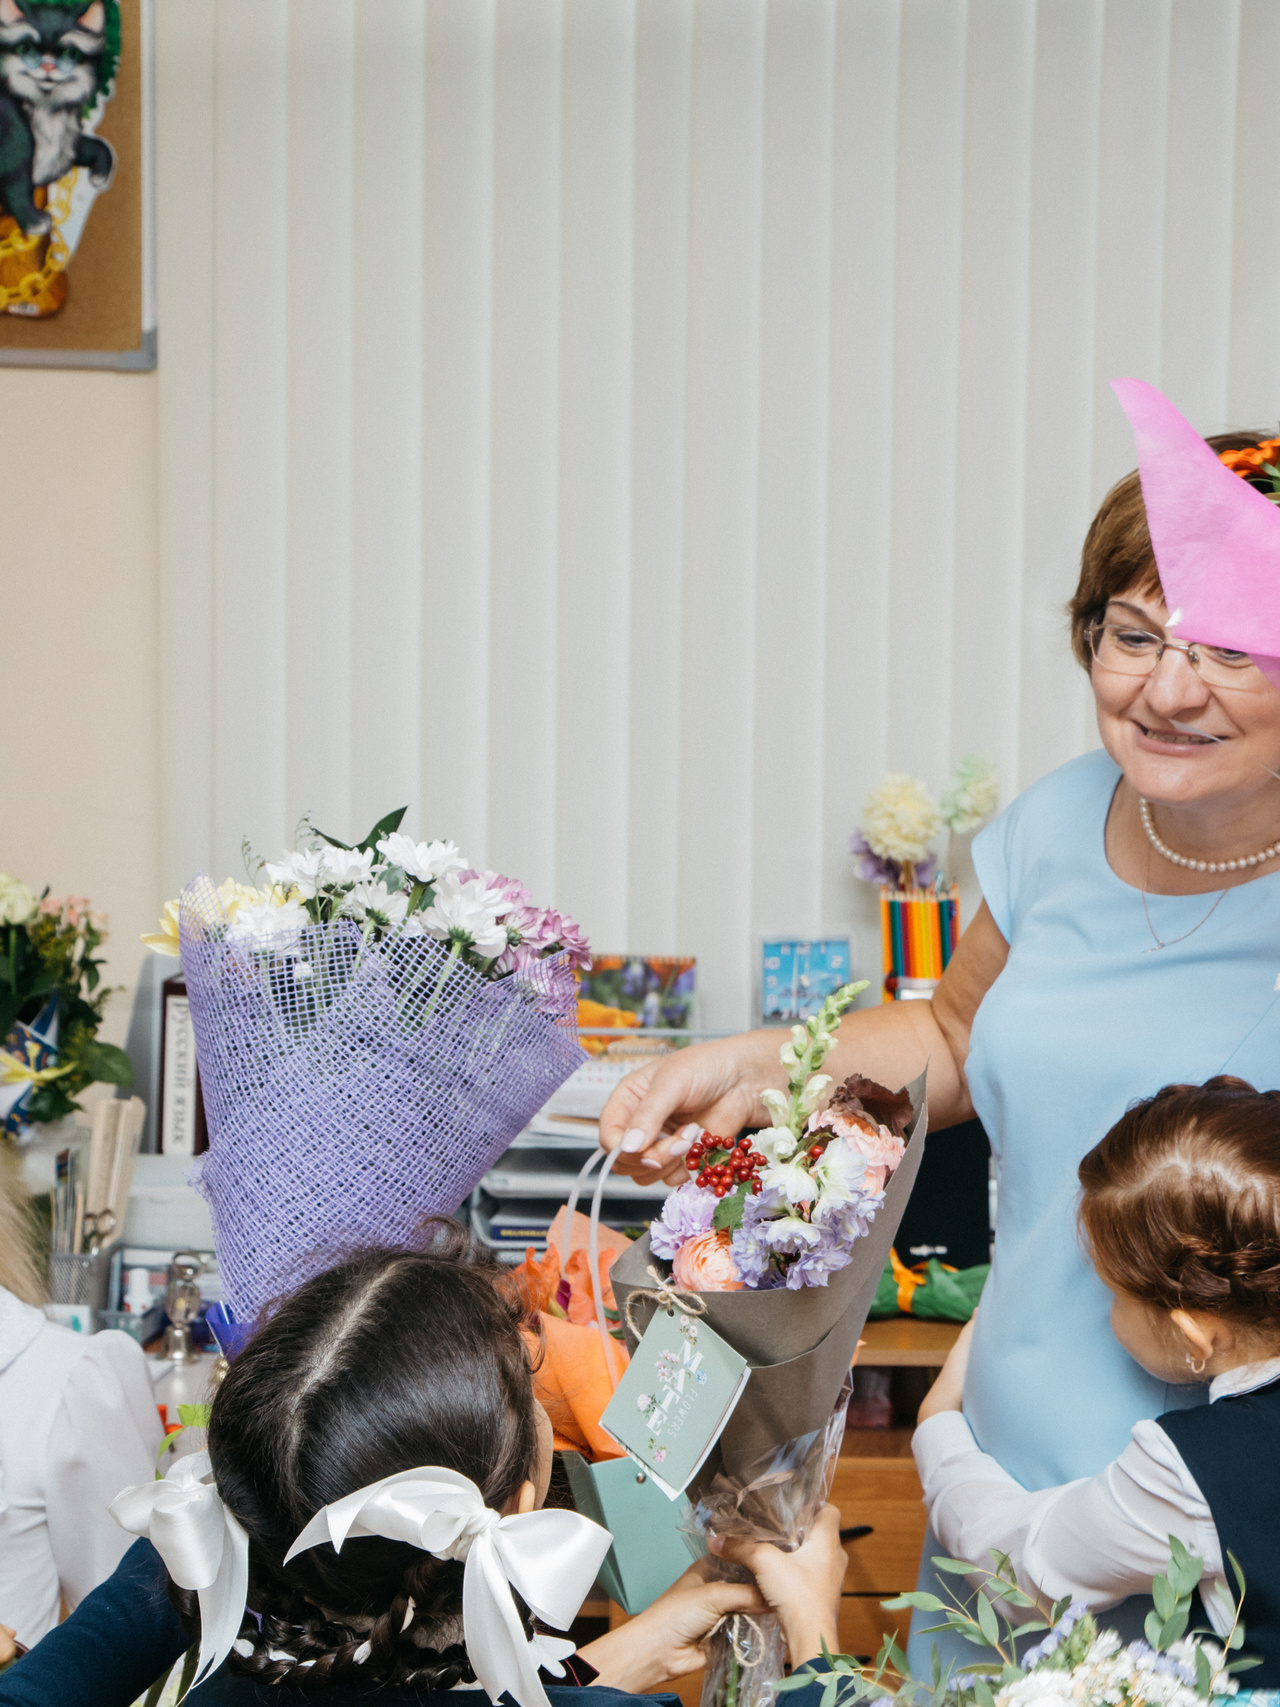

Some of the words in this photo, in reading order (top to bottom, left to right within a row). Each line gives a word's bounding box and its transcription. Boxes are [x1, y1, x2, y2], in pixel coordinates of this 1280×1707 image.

[764, 956, 781, 970] 10
[830, 954, 843, 969] 2
[646, 1338, 705, 1436] MATE
[667, 1387, 699, 1439] FLOWERS
